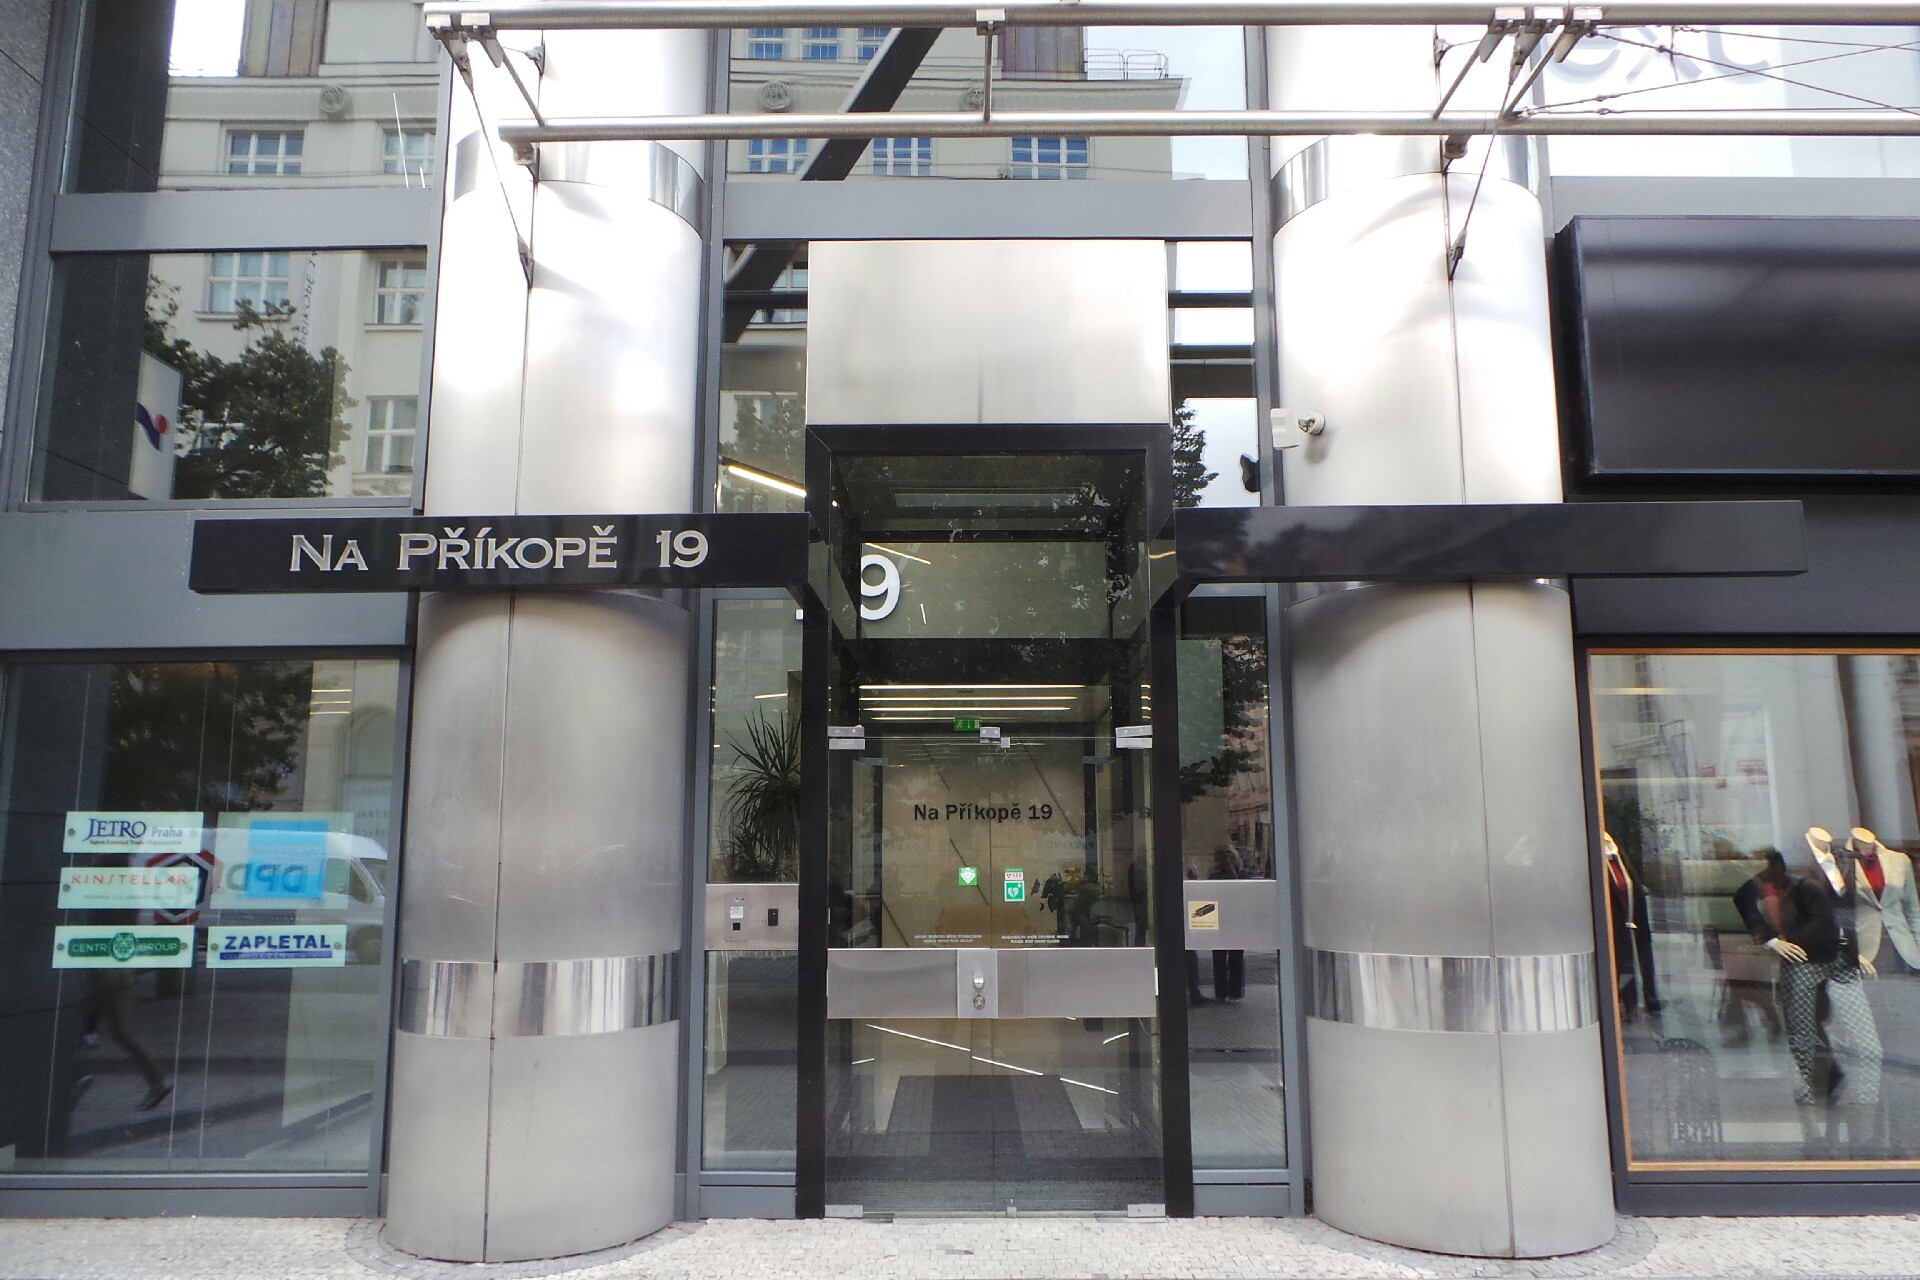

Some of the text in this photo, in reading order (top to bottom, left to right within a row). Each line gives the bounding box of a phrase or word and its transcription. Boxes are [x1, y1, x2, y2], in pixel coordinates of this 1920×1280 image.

[397, 524, 618, 571] PŘÍKOPĚ
[656, 529, 709, 568] 19
[914, 802, 1053, 823] Na Příkopě 19
[82, 818, 183, 841] JETRO Praha
[71, 874, 188, 885] KINSTELLAR
[139, 942, 178, 952] GROUP
[224, 935, 331, 950] ZAPLETAL
